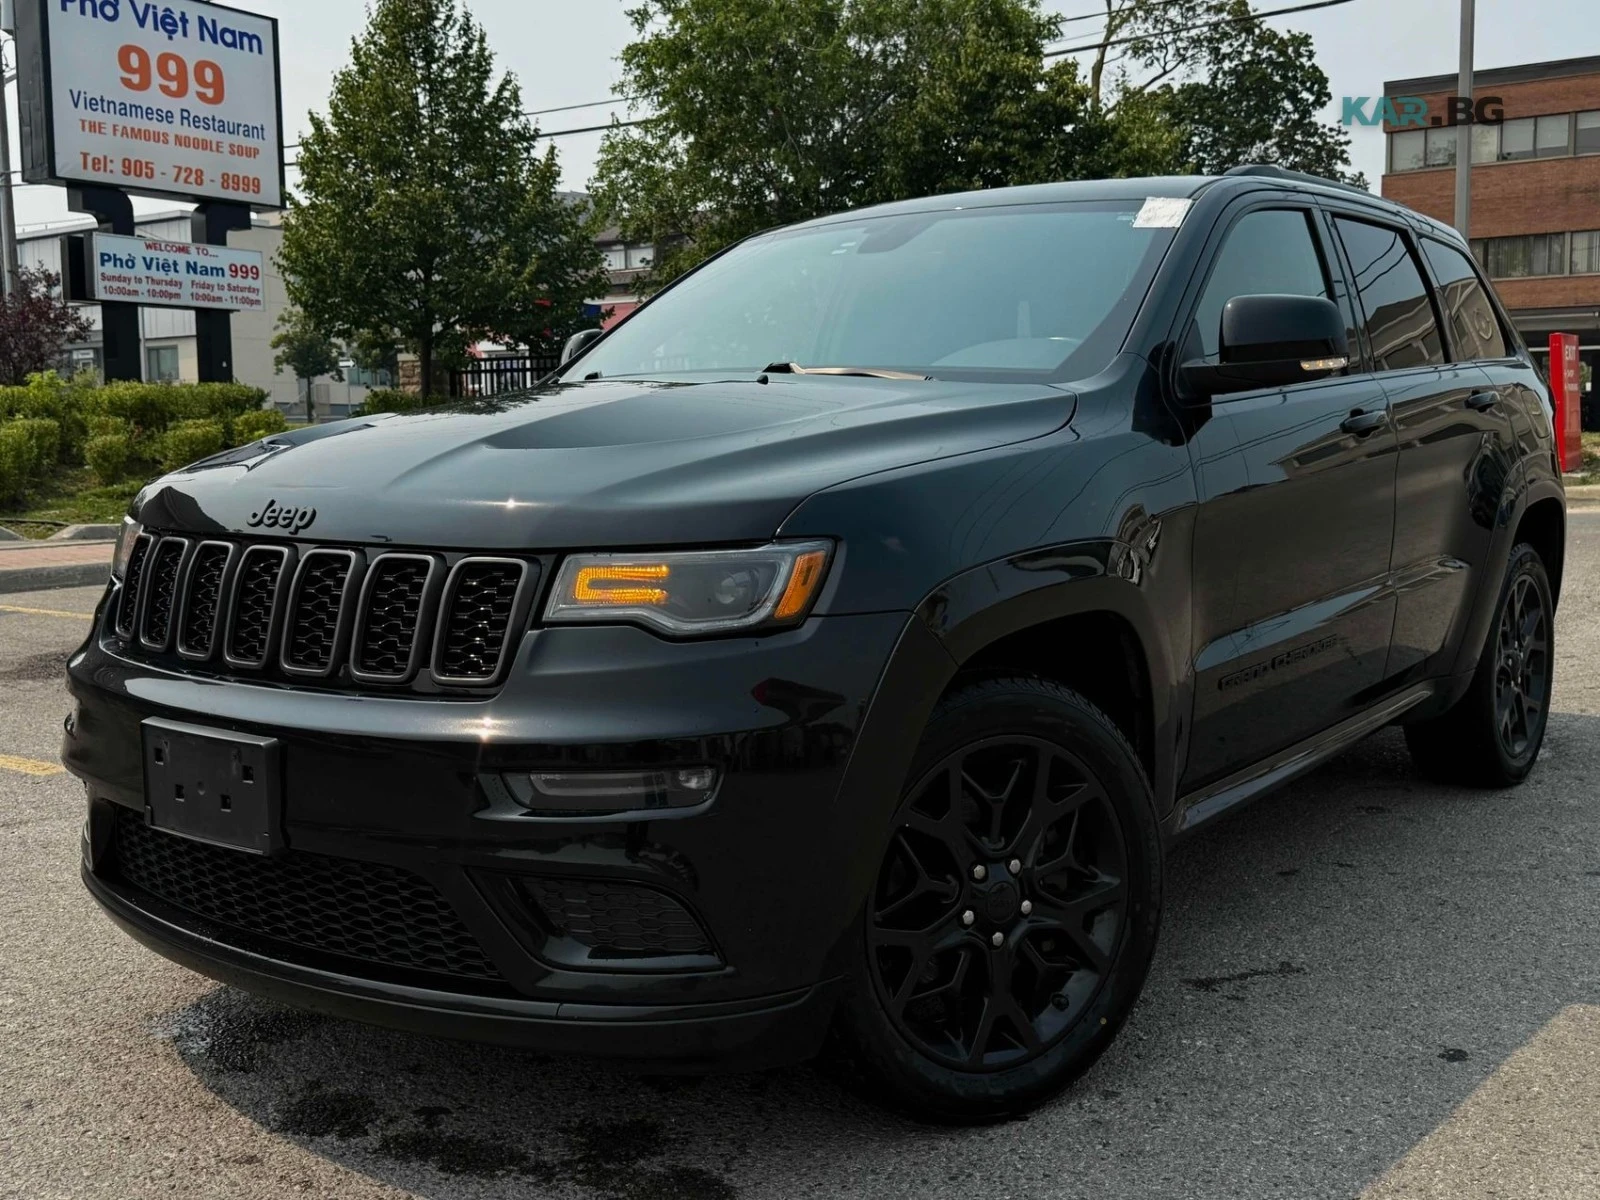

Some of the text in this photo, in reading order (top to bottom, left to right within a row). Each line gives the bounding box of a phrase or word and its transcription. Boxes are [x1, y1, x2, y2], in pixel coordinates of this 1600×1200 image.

[129, 0, 189, 41] Việt
[198, 15, 263, 55] Nam
[117, 44, 225, 106] 999
[69, 89, 266, 141] Vietnamese Restaurant
[79, 118, 260, 159] THE FAMOUS NOODLE SOUP
[80, 151, 114, 174] Tel:
[121, 157, 155, 179] 905
[172, 164, 204, 187] 728
[221, 172, 261, 194] 8999
[144, 241, 191, 255] WELCOME
[100, 272, 183, 290] Sunday to Thursday
[142, 256, 180, 276] Việt
[185, 260, 225, 278] Nam
[229, 262, 260, 280] 999
[103, 285, 140, 297] 10:00am
[147, 288, 182, 301] 10:00pm
[190, 291, 224, 304] 10:00am
[230, 295, 262, 307] 11:00pm
[191, 280, 260, 296] Friday to Saturday
[246, 499, 317, 536] Jeep
